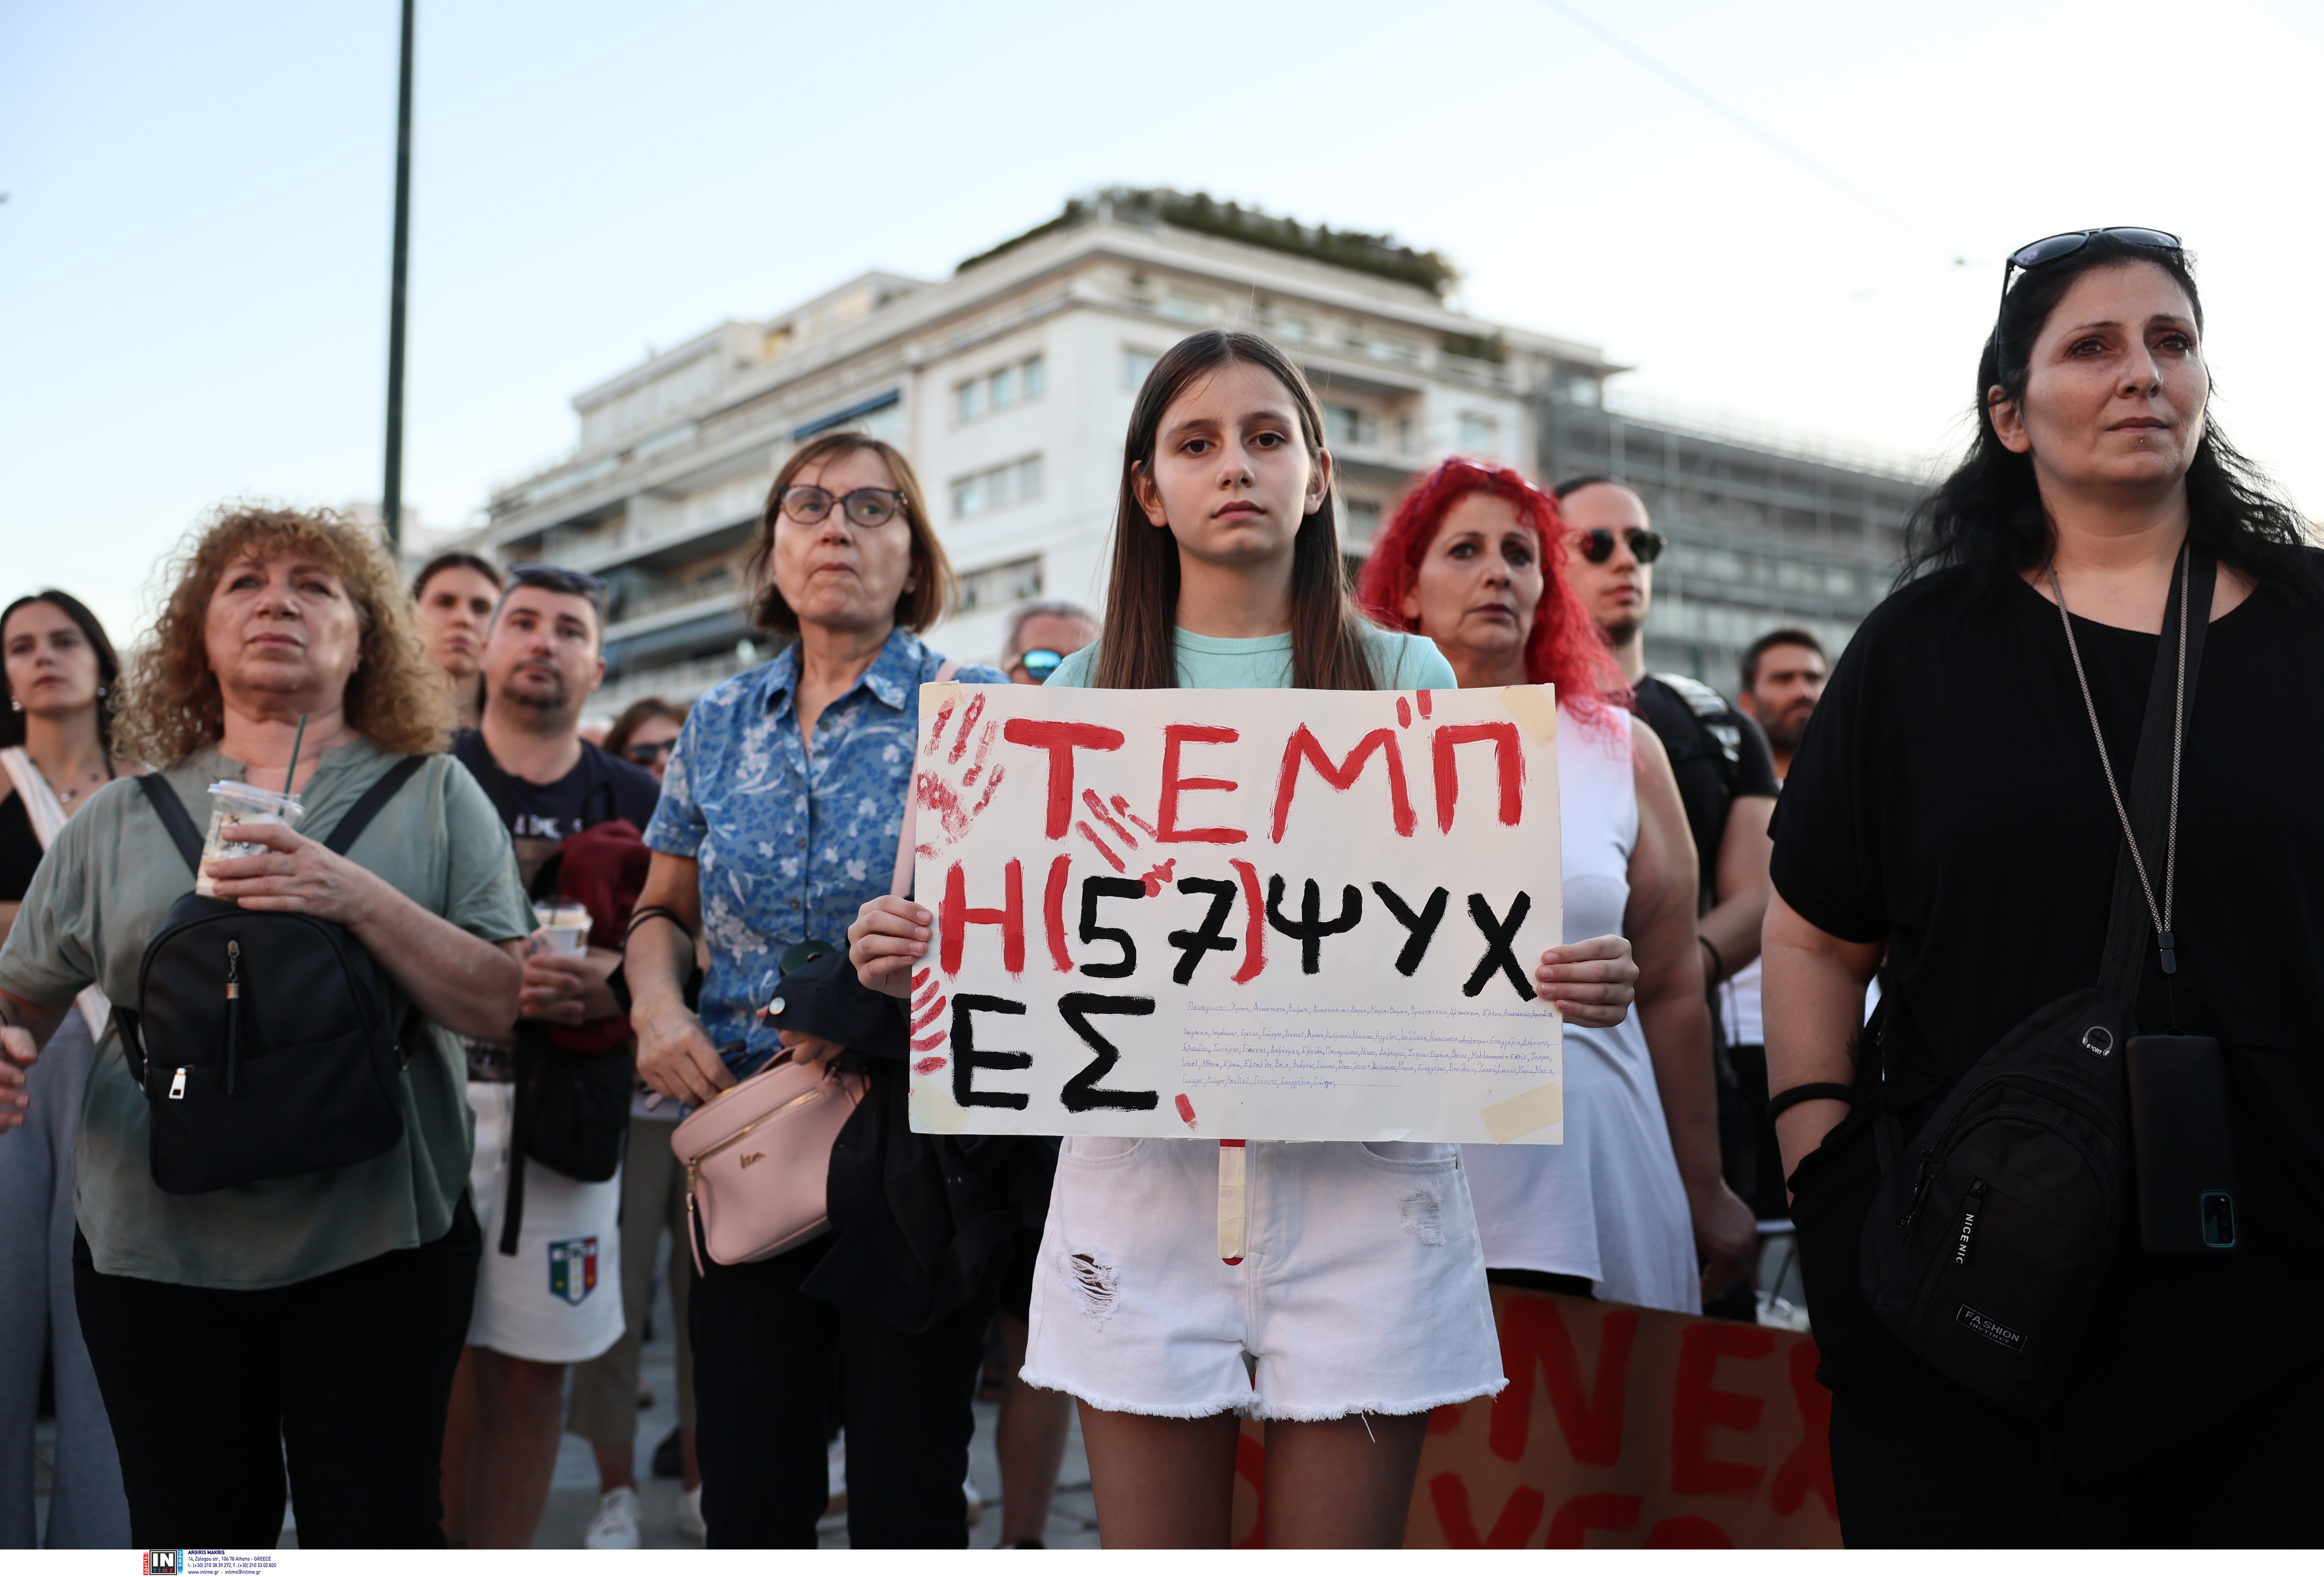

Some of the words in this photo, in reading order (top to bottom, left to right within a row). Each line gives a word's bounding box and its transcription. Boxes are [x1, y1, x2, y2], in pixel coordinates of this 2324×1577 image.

[2086, 1043, 2103, 1055] SPORT
[1965, 1310, 2020, 1342] FASHION
[1969, 1321, 2010, 1343] INSTINCT
